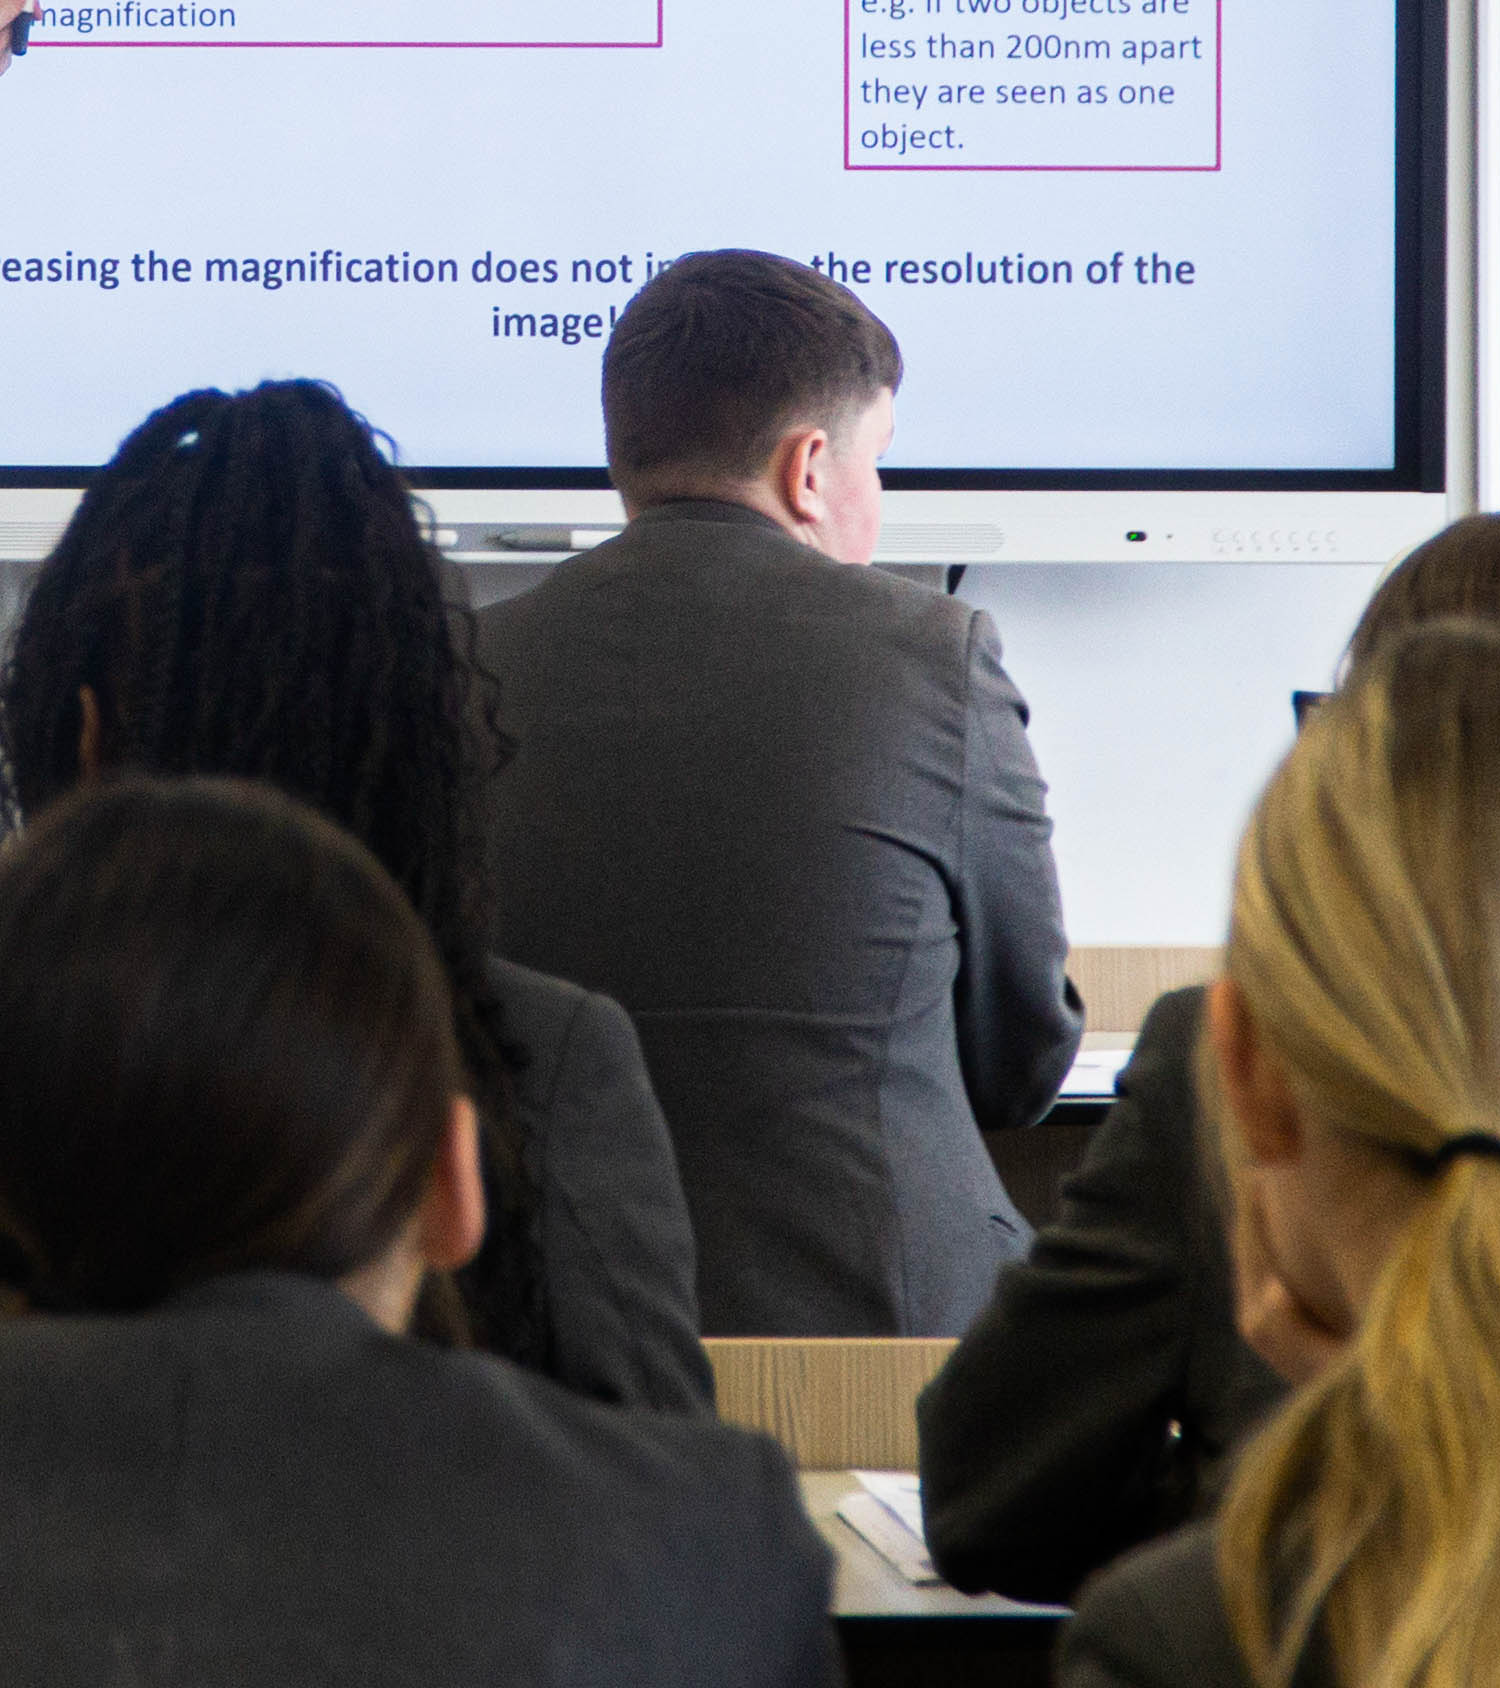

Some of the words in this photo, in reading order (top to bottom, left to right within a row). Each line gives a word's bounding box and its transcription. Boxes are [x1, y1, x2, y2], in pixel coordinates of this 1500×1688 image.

[861, 32, 917, 59] less
[926, 32, 995, 60] than
[1006, 33, 1111, 60] 200nm
[1121, 35, 1202, 66] apart
[860, 77, 928, 111] they
[937, 84, 986, 105] are
[995, 84, 1066, 105] seen
[1076, 84, 1108, 105] as
[1117, 84, 1175, 105] one
[860, 122, 964, 156] object.
[130, 249, 192, 283] the
[205, 248, 458, 291] magnification
[471, 250, 559, 284] does
[571, 254, 633, 284] not
[809, 251, 872, 285] the
[884, 251, 1073, 285] resolution
[1085, 250, 1124, 285] of
[1133, 251, 1196, 285] the
